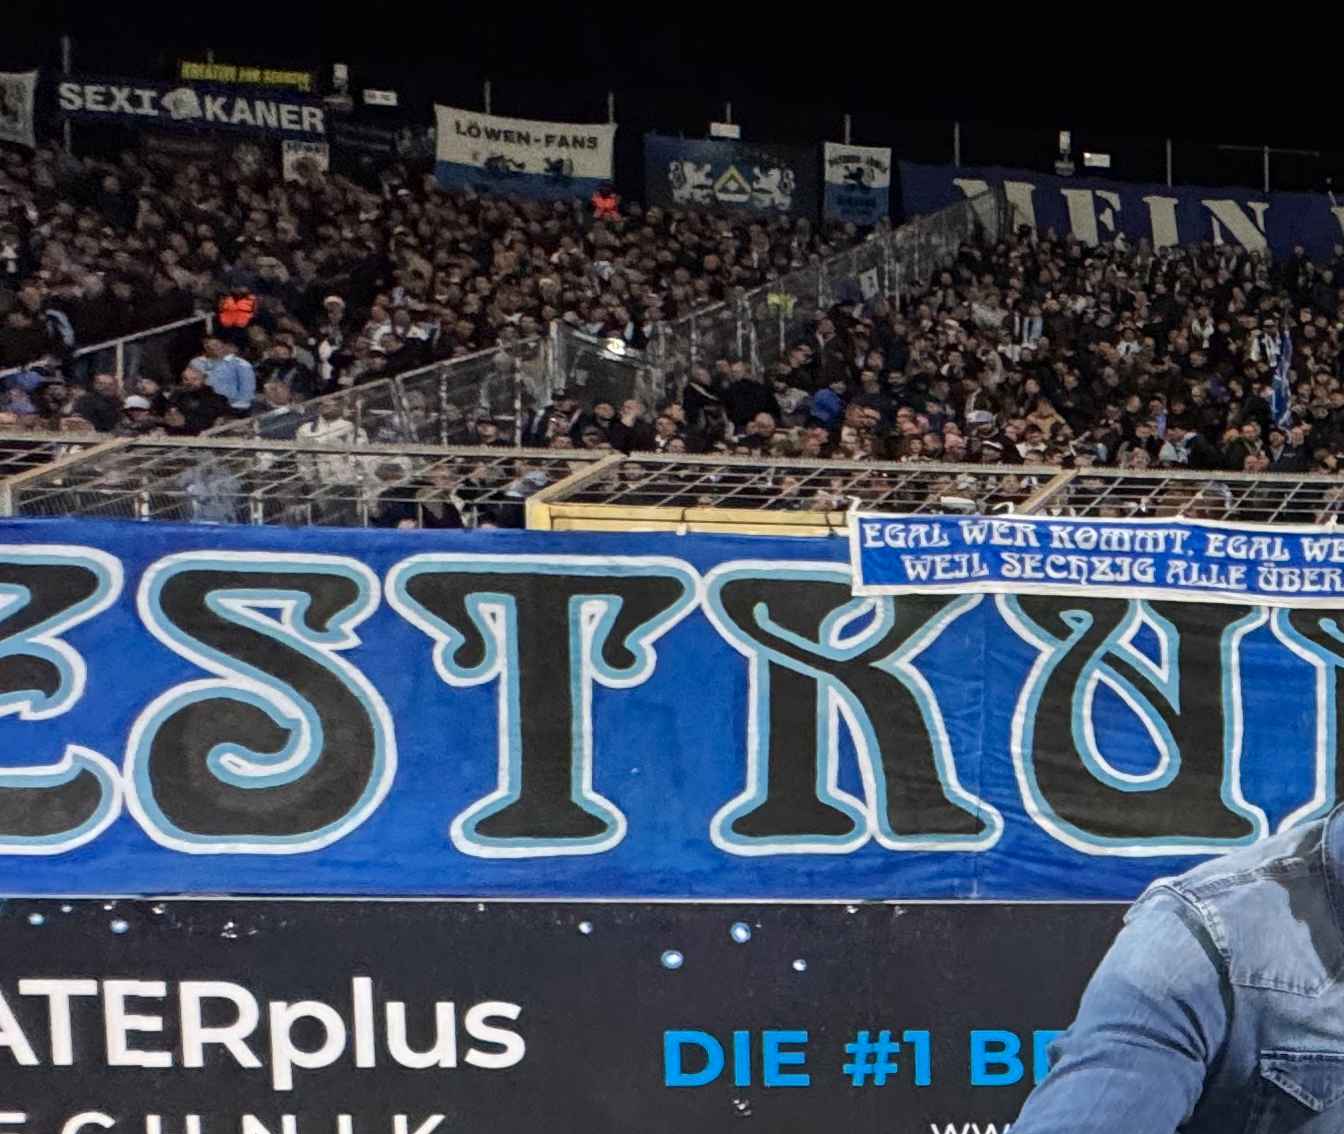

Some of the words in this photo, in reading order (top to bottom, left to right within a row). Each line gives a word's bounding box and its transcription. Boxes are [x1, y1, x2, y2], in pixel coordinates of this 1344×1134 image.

[59, 82, 160, 117] SEXI
[203, 94, 325, 133] KANER
[455, 119, 598, 150] LÖWEN-FANS
[861, 522, 950, 549] EGAL
[958, 519, 1041, 548] WER
[1205, 533, 1291, 561] EGAL
[900, 552, 990, 582] WEIL
[999, 552, 1156, 585] SECHZIG
[1165, 559, 1248, 590] ALLE
[663, 1030, 810, 1088] DIE
[843, 1030, 932, 1088] #1
